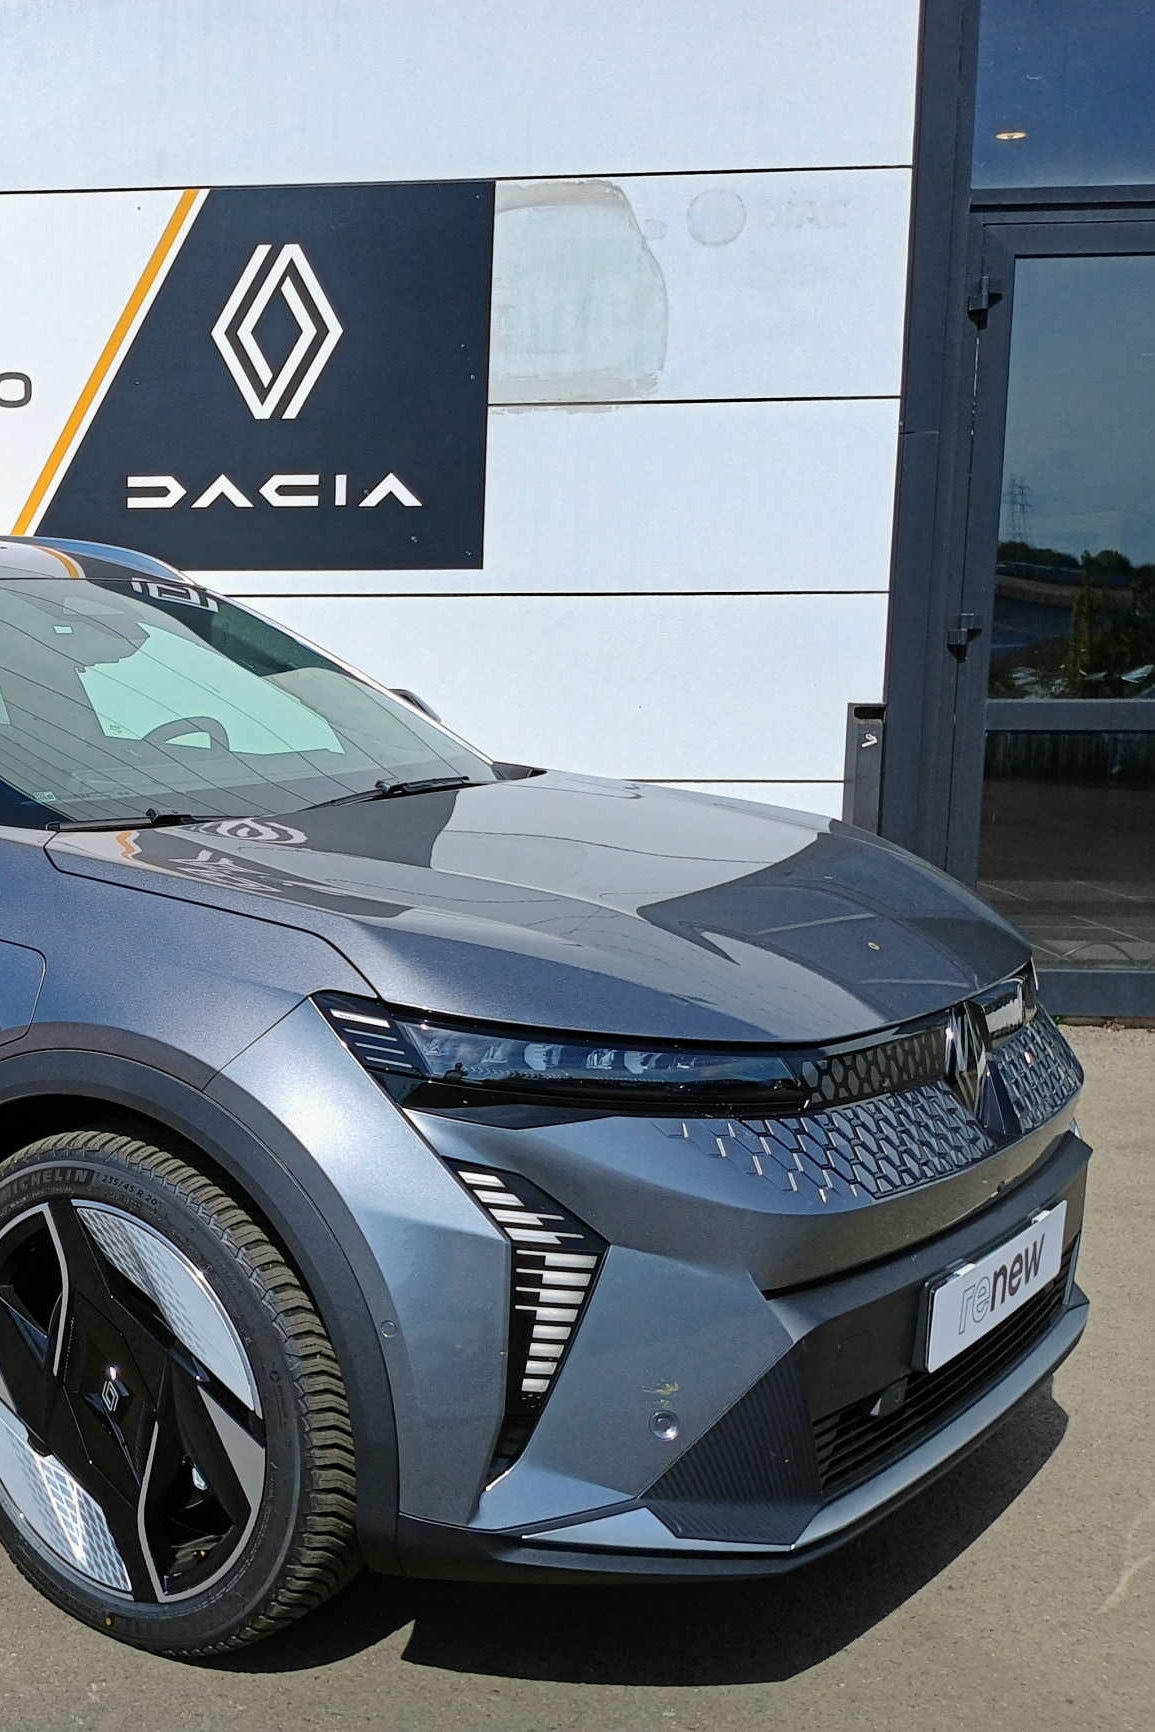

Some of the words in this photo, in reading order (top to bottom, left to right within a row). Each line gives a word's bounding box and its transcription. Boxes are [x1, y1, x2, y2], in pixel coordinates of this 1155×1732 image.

[126, 472, 423, 509] DACIA
[0, 1168, 89, 1200] MICHELIN
[958, 1233, 1046, 1336] renew
